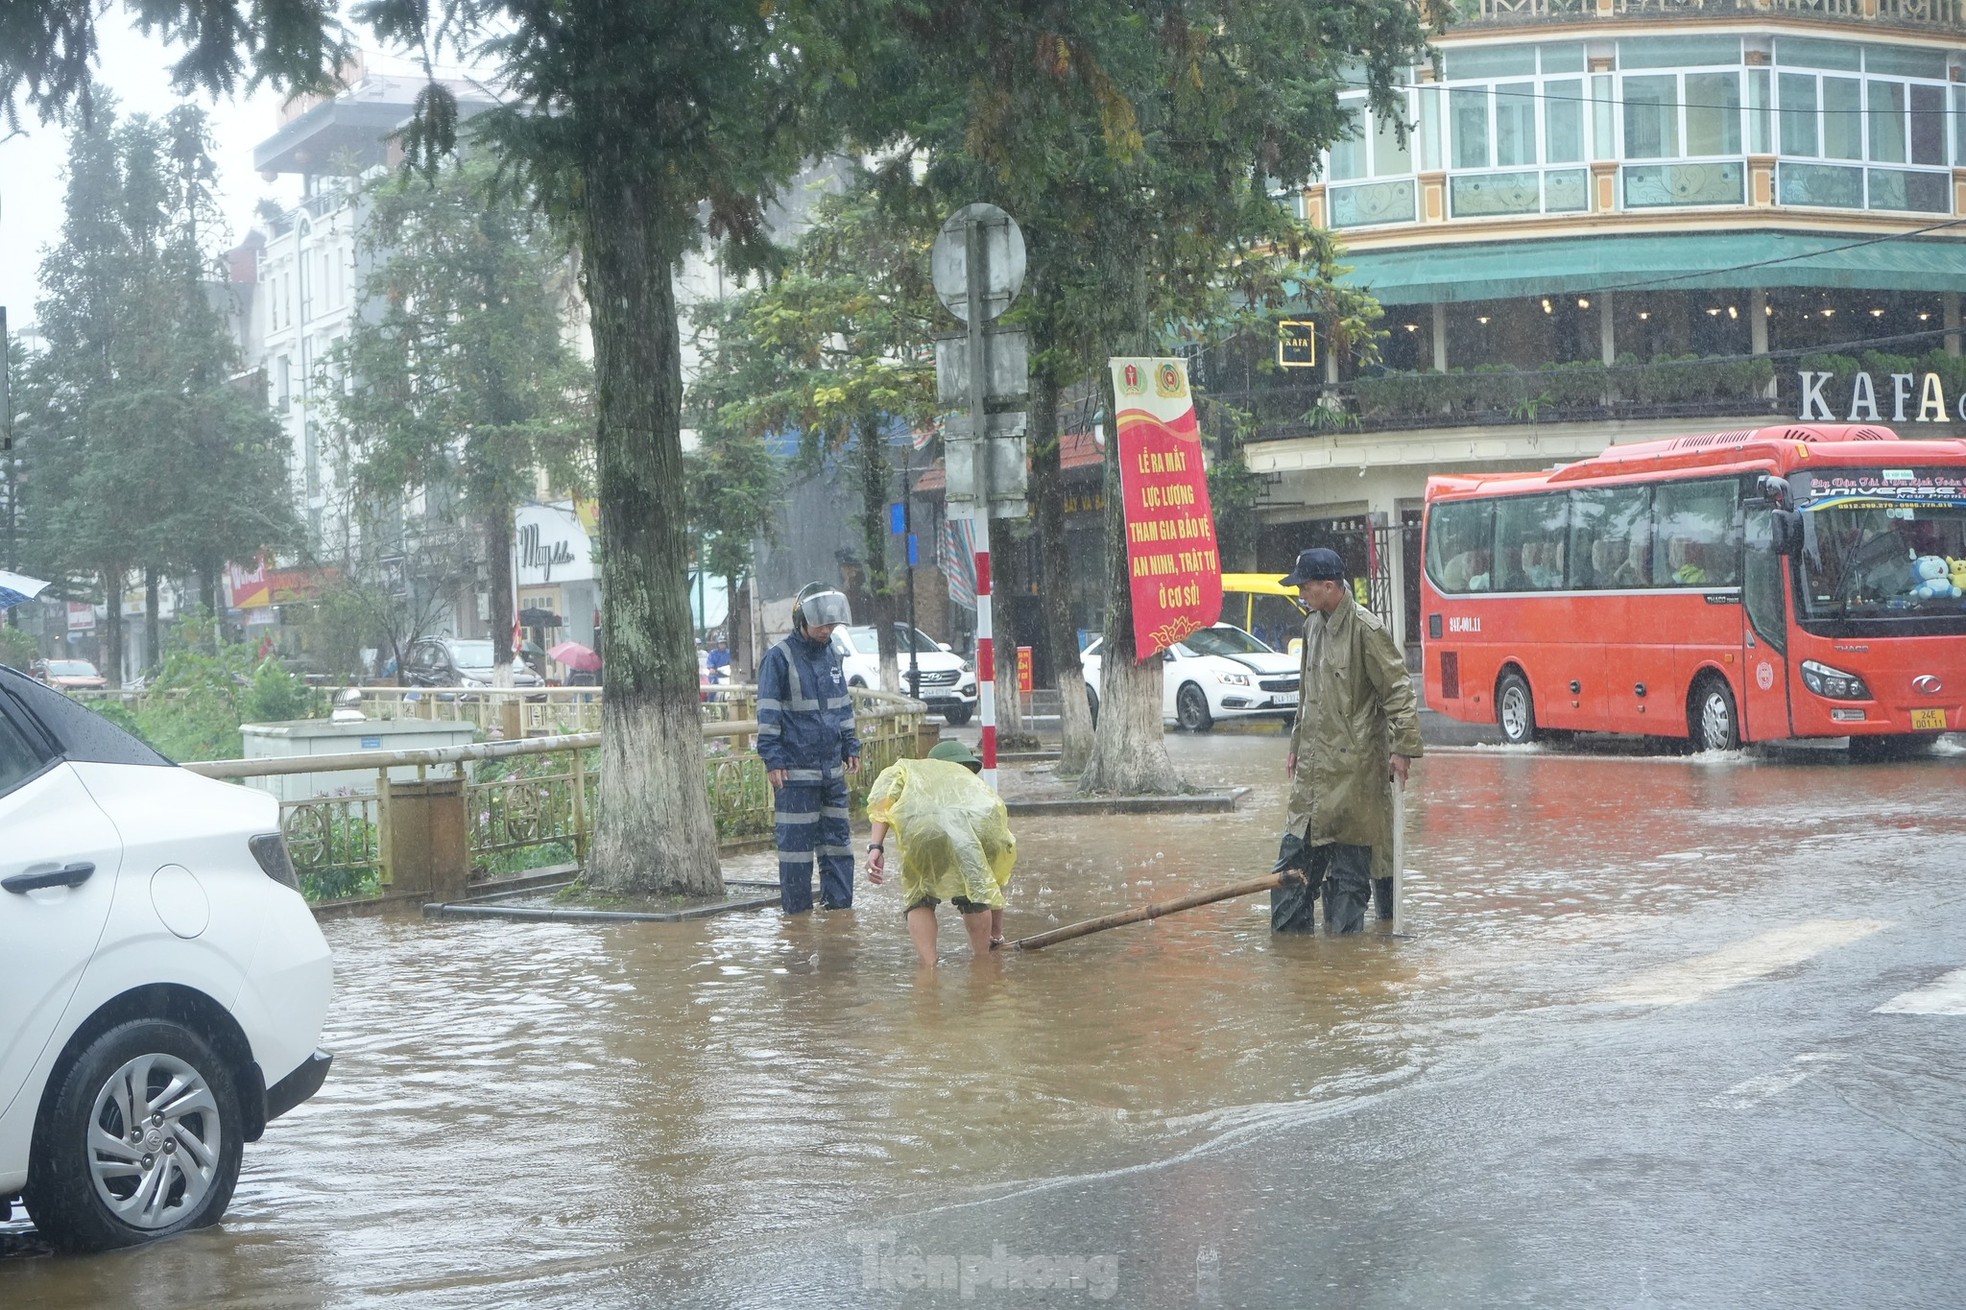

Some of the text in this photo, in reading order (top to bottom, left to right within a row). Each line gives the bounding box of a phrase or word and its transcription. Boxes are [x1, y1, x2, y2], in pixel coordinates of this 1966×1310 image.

[1798, 371, 1951, 422] KAFA
[1151, 453, 1165, 473] RA
[1165, 444, 1186, 472] MẮT
[1141, 483, 1195, 512] LỰC LƯỢNG
[1129, 511, 1211, 543] THAM GIA BẢO VỆ
[1133, 547, 1216, 578] AN NINH, TRẬT TỰ
[1159, 578, 1200, 609] Ở CƠ SỞ!
[1921, 710, 1936, 719] 24E
